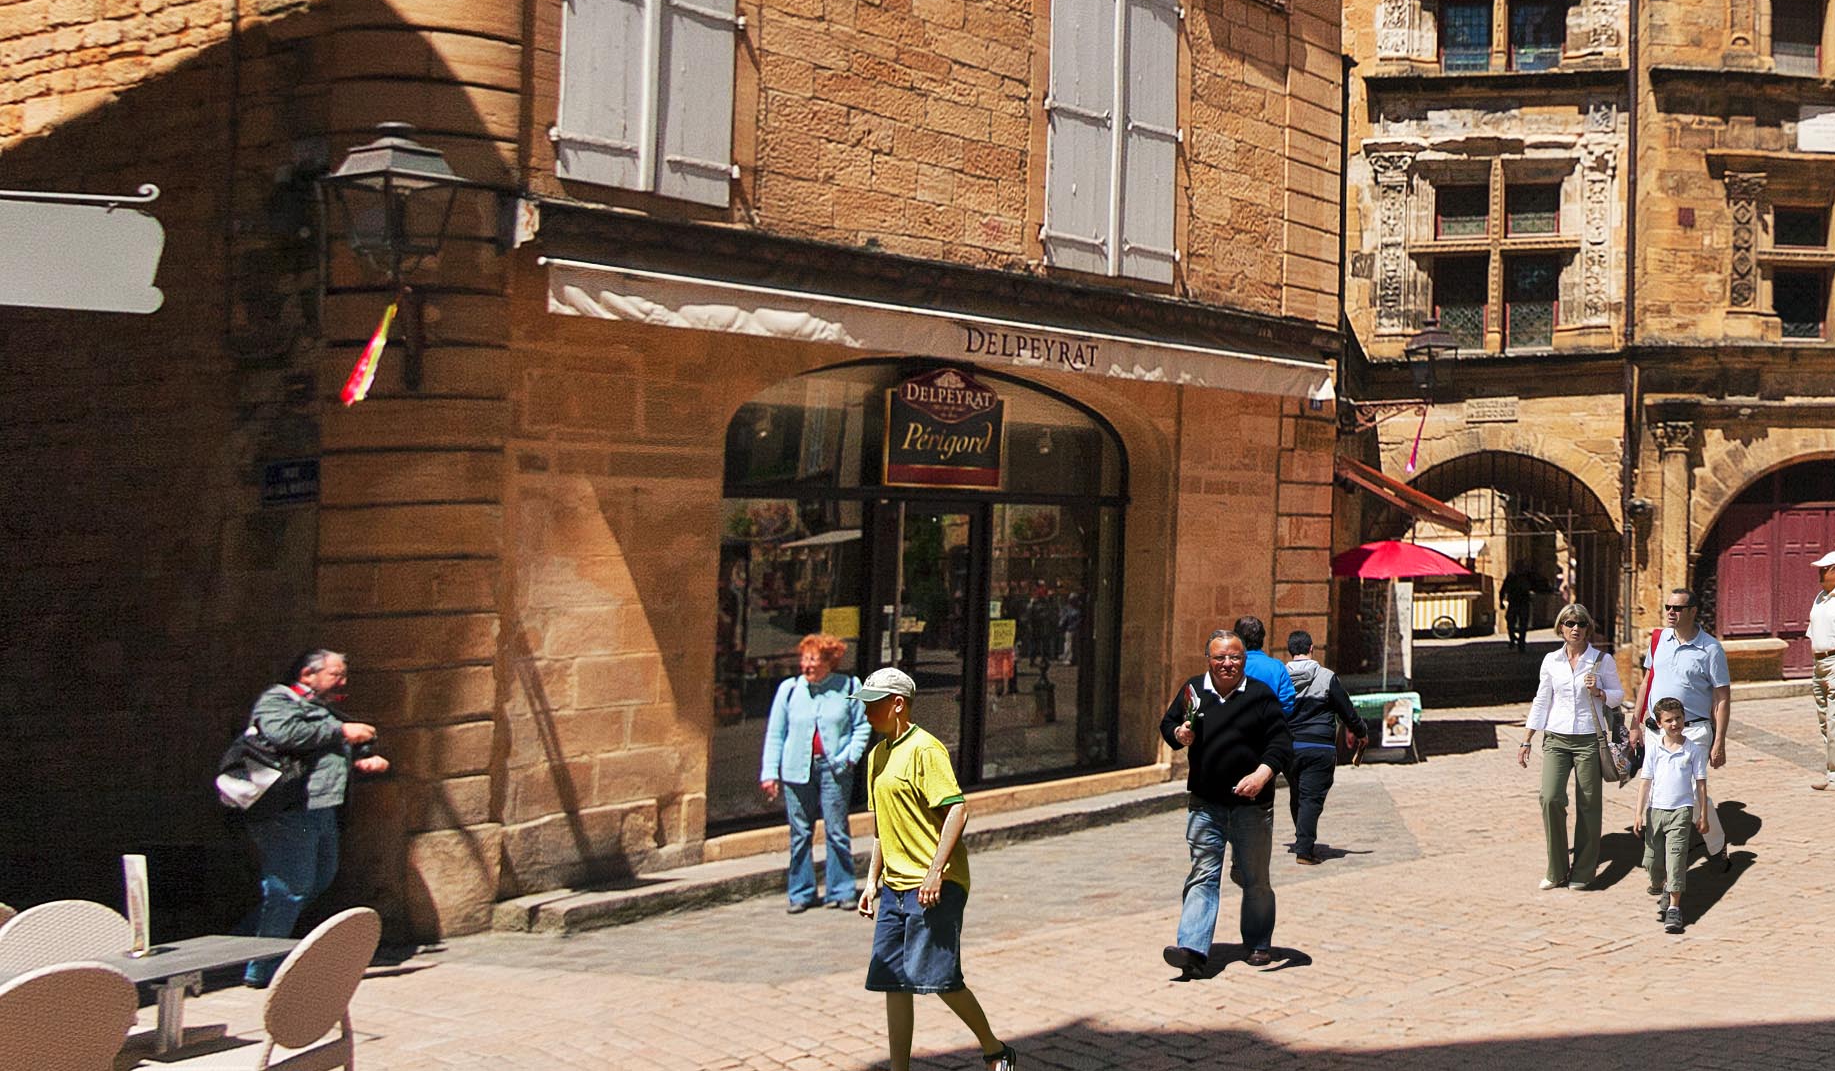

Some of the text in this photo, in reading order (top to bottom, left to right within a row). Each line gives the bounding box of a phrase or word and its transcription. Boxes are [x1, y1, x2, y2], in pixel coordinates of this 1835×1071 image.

[965, 326, 1099, 371] DELPEYRAT
[906, 382, 993, 410] DELPEYRAT
[900, 421, 994, 461] Périgord
